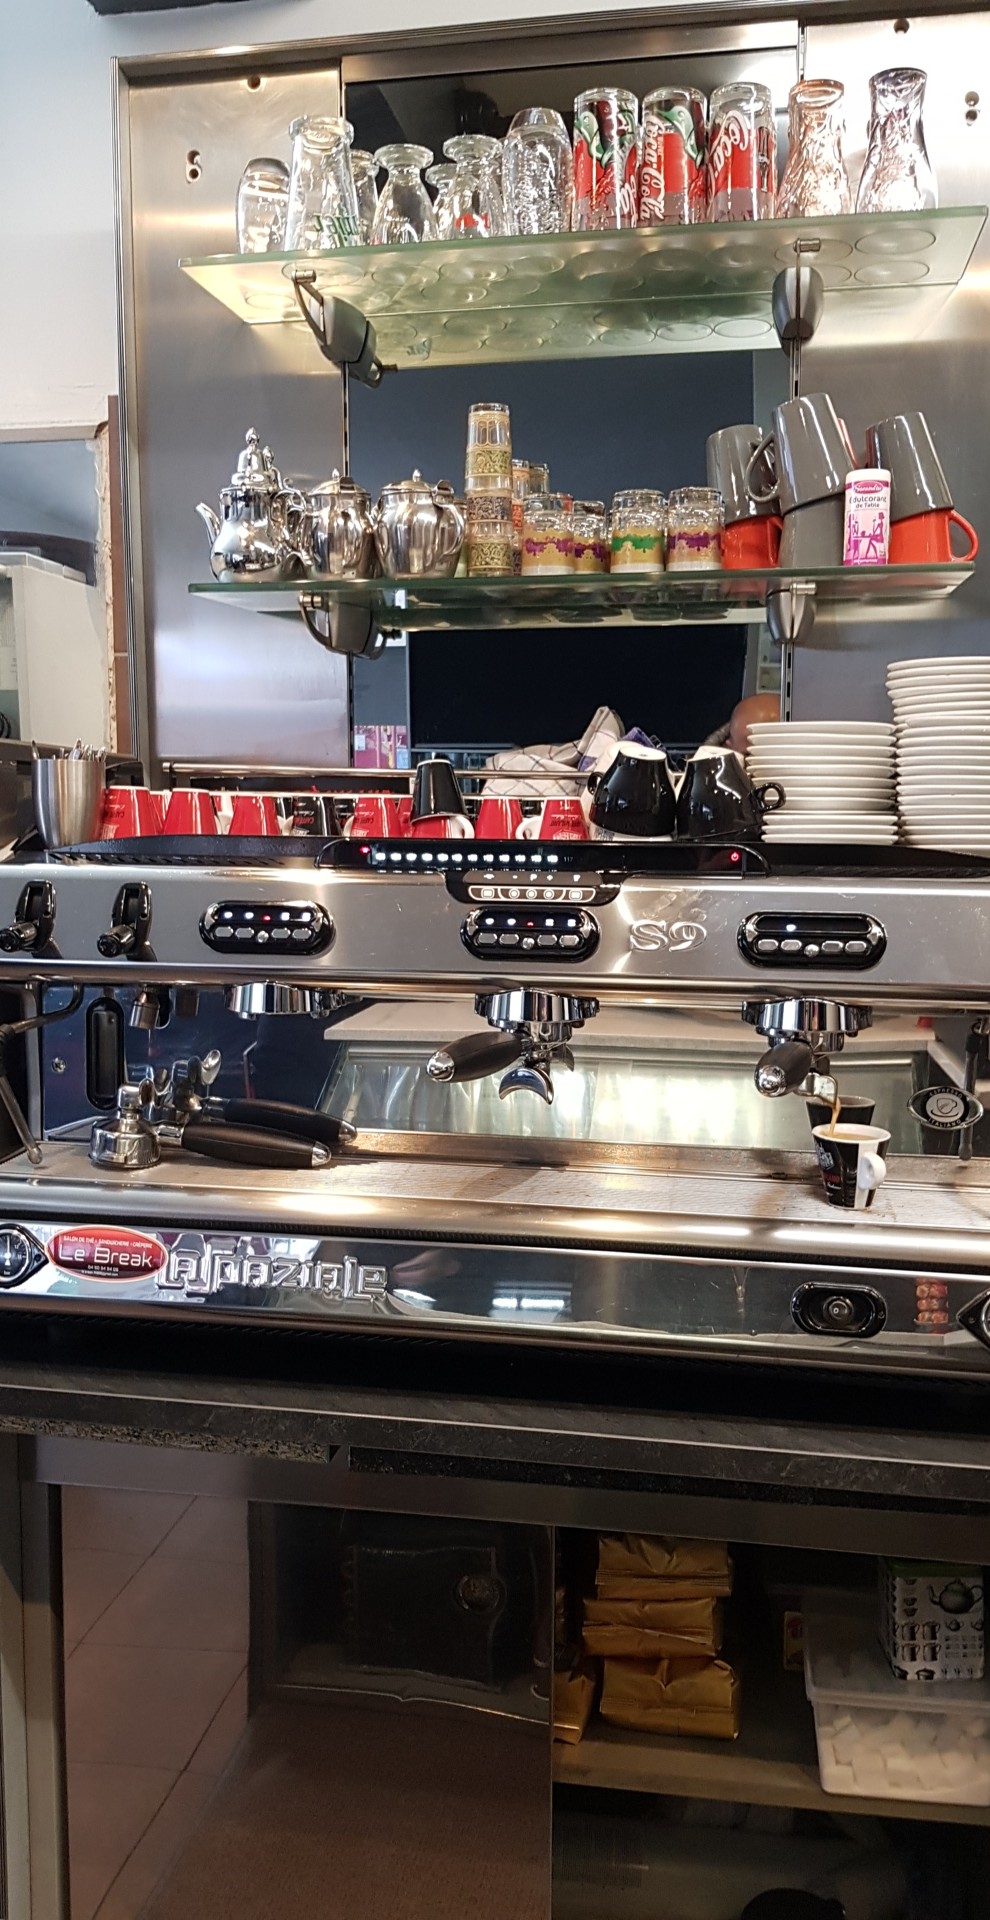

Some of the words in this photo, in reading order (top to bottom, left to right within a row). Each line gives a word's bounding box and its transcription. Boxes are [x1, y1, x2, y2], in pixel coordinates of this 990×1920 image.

[642, 115, 665, 221] Coca-Cola
[630, 919, 707, 952] S9
[929, 1088, 963, 1099] ESPRESSO
[928, 1117, 962, 1128] ITALIANO
[98, 1238, 129, 1247] SANDWICHERIE
[59, 1244, 86, 1262] Le
[94, 1247, 152, 1267] Break
